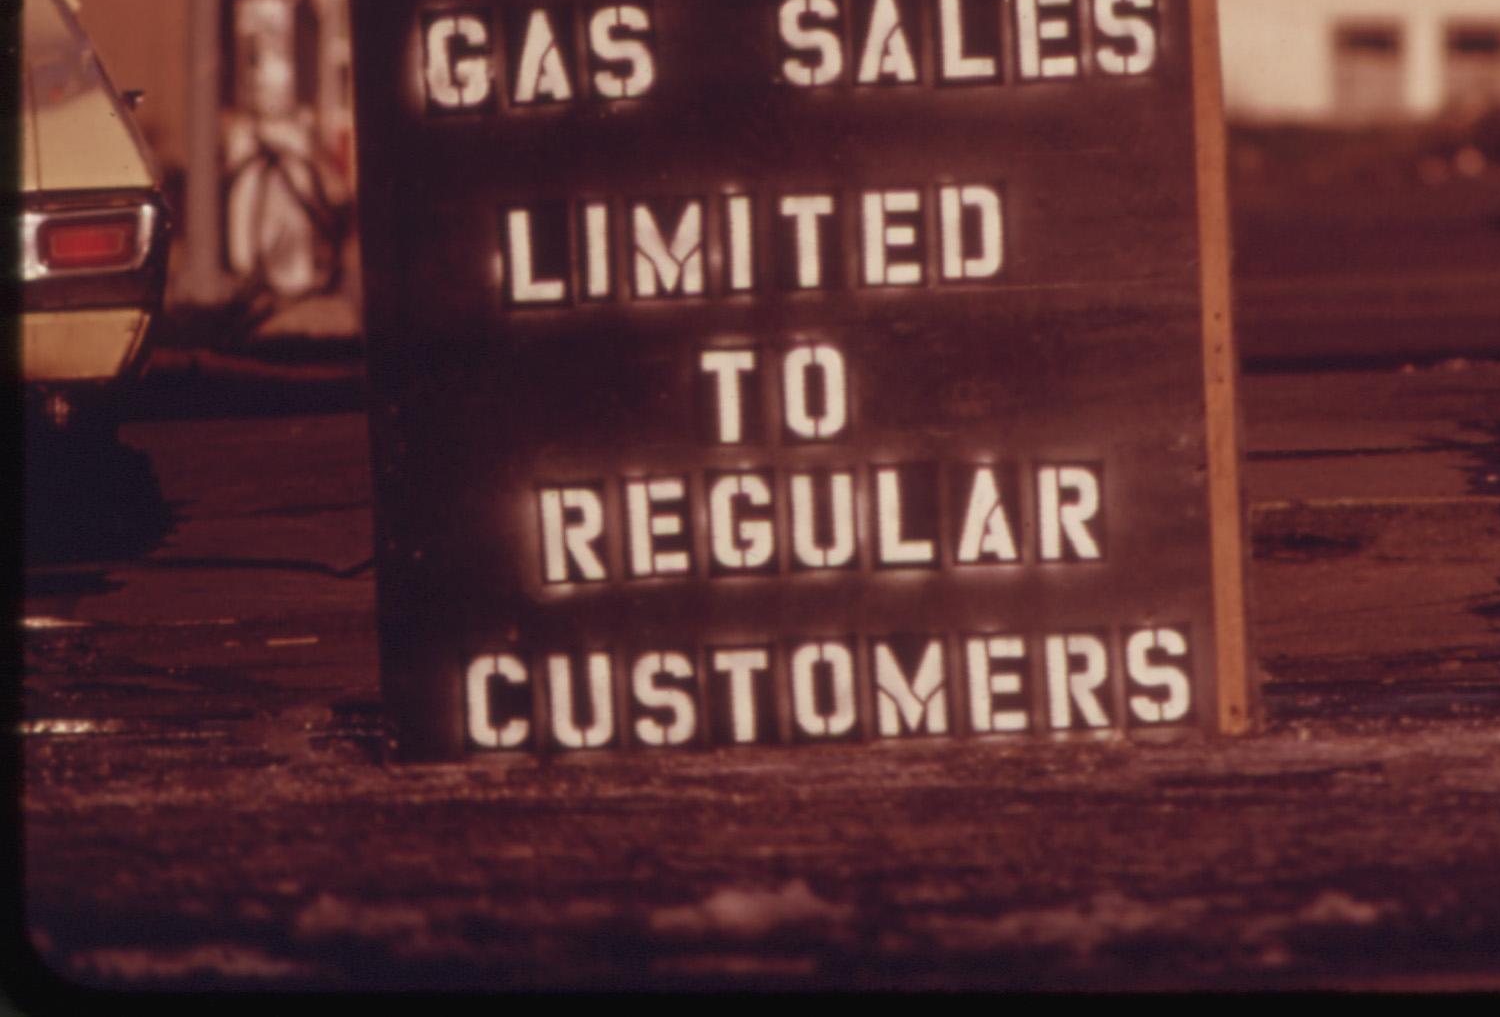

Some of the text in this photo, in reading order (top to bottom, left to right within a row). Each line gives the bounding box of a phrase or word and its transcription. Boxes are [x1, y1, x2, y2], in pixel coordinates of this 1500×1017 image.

[424, 4, 655, 108] GAS
[508, 187, 1002, 302] LIMITED
[701, 345, 847, 443] TO
[540, 465, 1102, 583] REGULAR
[465, 627, 1191, 749] CUSTOMERS
